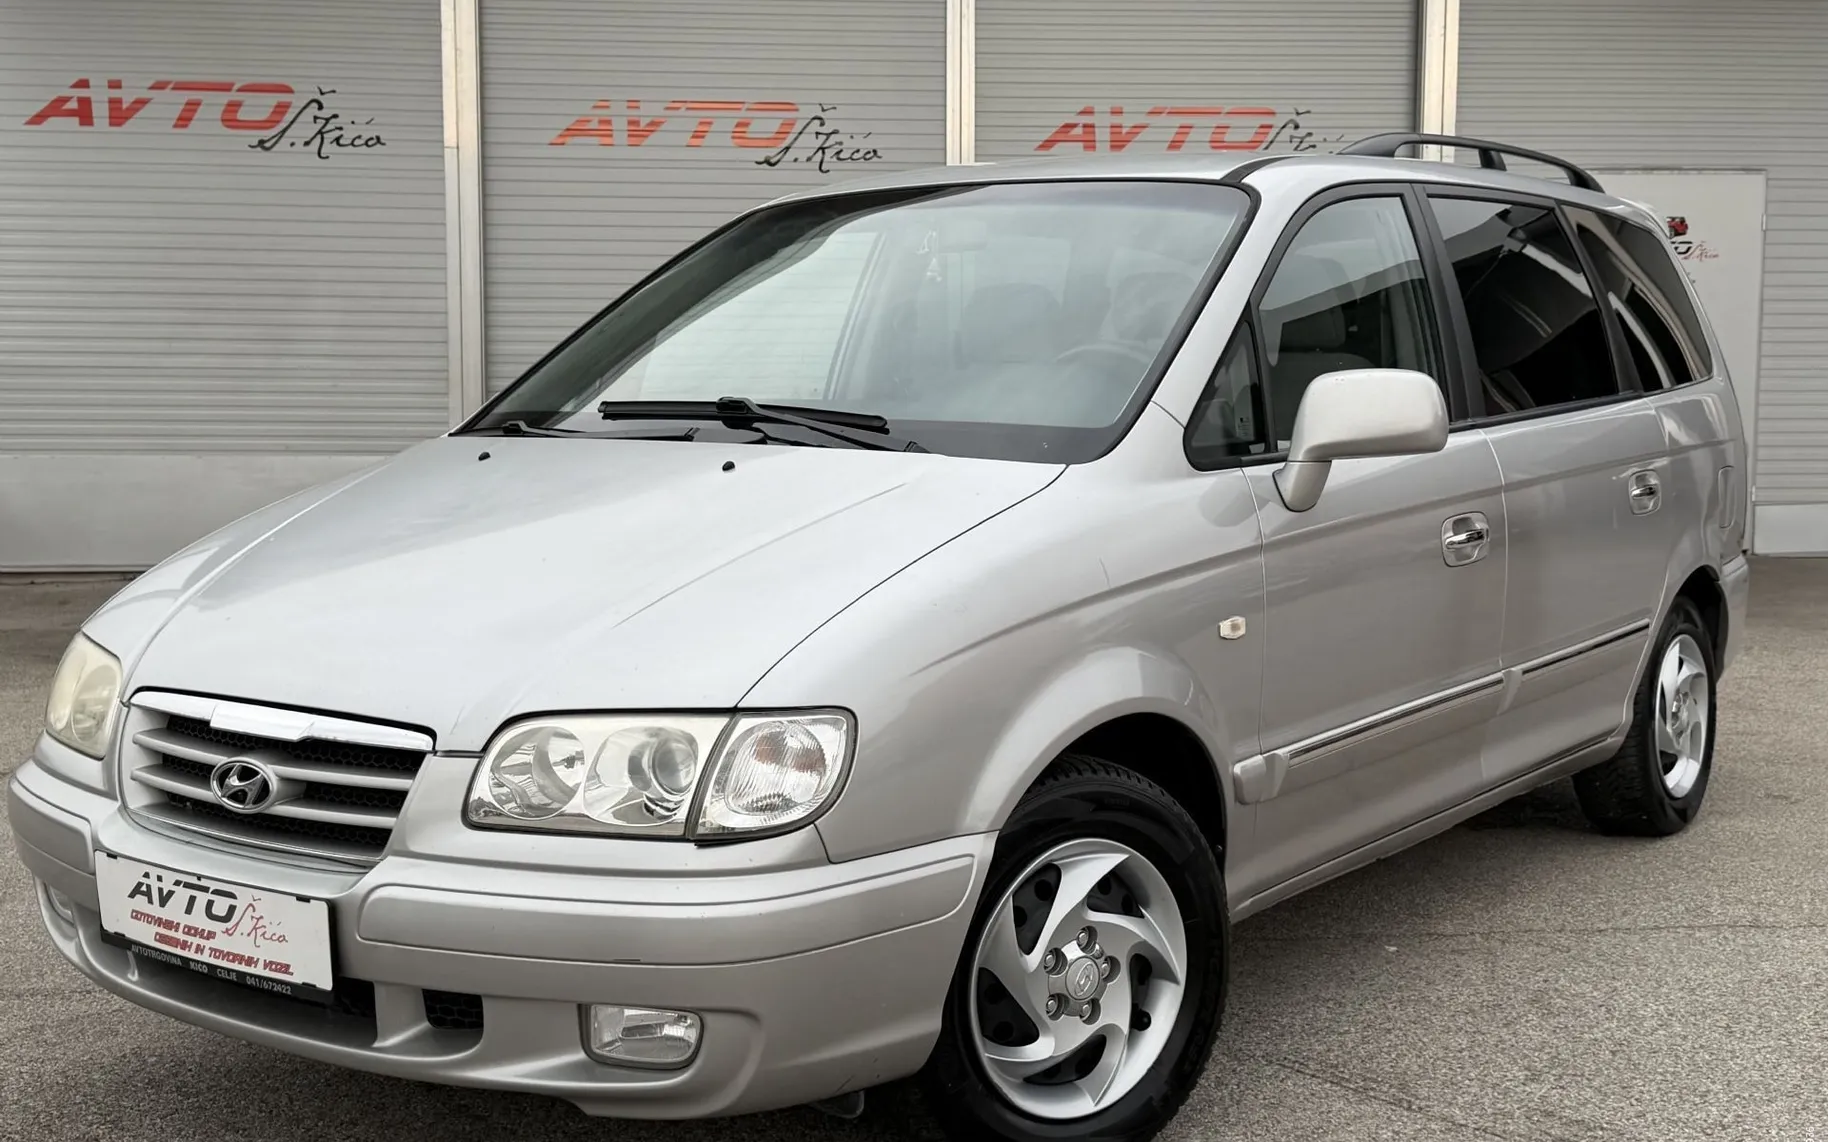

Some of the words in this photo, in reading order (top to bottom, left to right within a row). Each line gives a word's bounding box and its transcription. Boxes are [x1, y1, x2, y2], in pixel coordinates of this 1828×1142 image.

[23, 78, 295, 131] AVTO
[548, 99, 799, 148] AVTO
[1033, 106, 1277, 152] AVTO
[127, 871, 238, 923] AVTO
[131, 944, 182, 966] AVTOTRGOVINA
[217, 968, 237, 981] CELJE
[246, 975, 292, 995] 041/672422
[194, 943, 206, 956] IN
[208, 946, 260, 968] TOVORNIH
